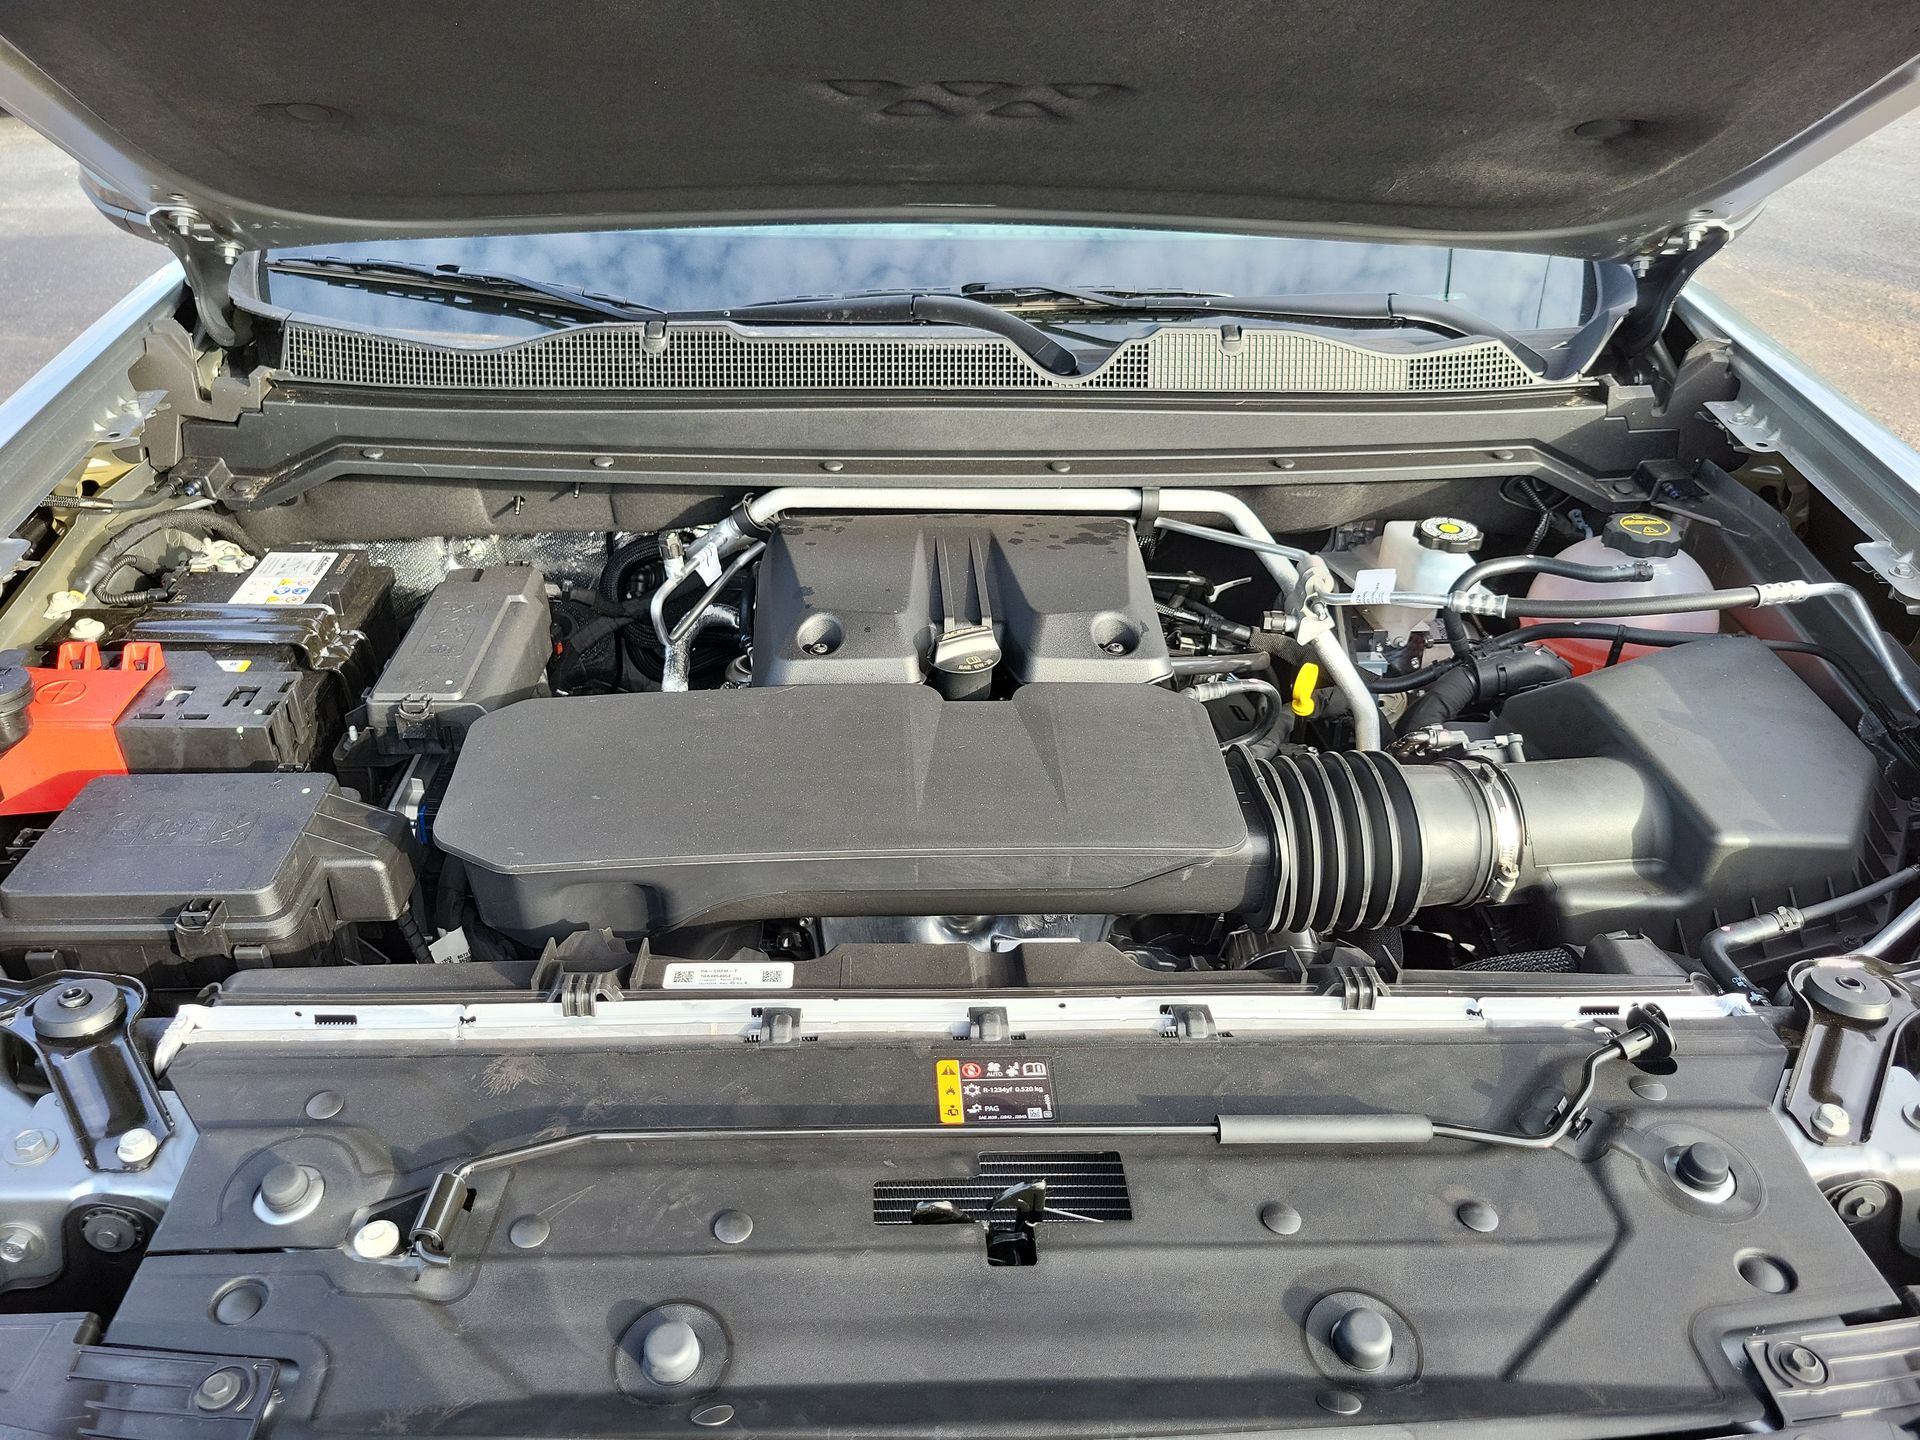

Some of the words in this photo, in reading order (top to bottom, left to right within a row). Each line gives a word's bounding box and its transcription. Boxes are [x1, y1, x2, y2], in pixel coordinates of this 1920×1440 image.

[983, 1086, 1013, 1094] R-1234yf
[1014, 1085, 1033, 1093] 0.520
[1034, 1085, 1044, 1093] kg
